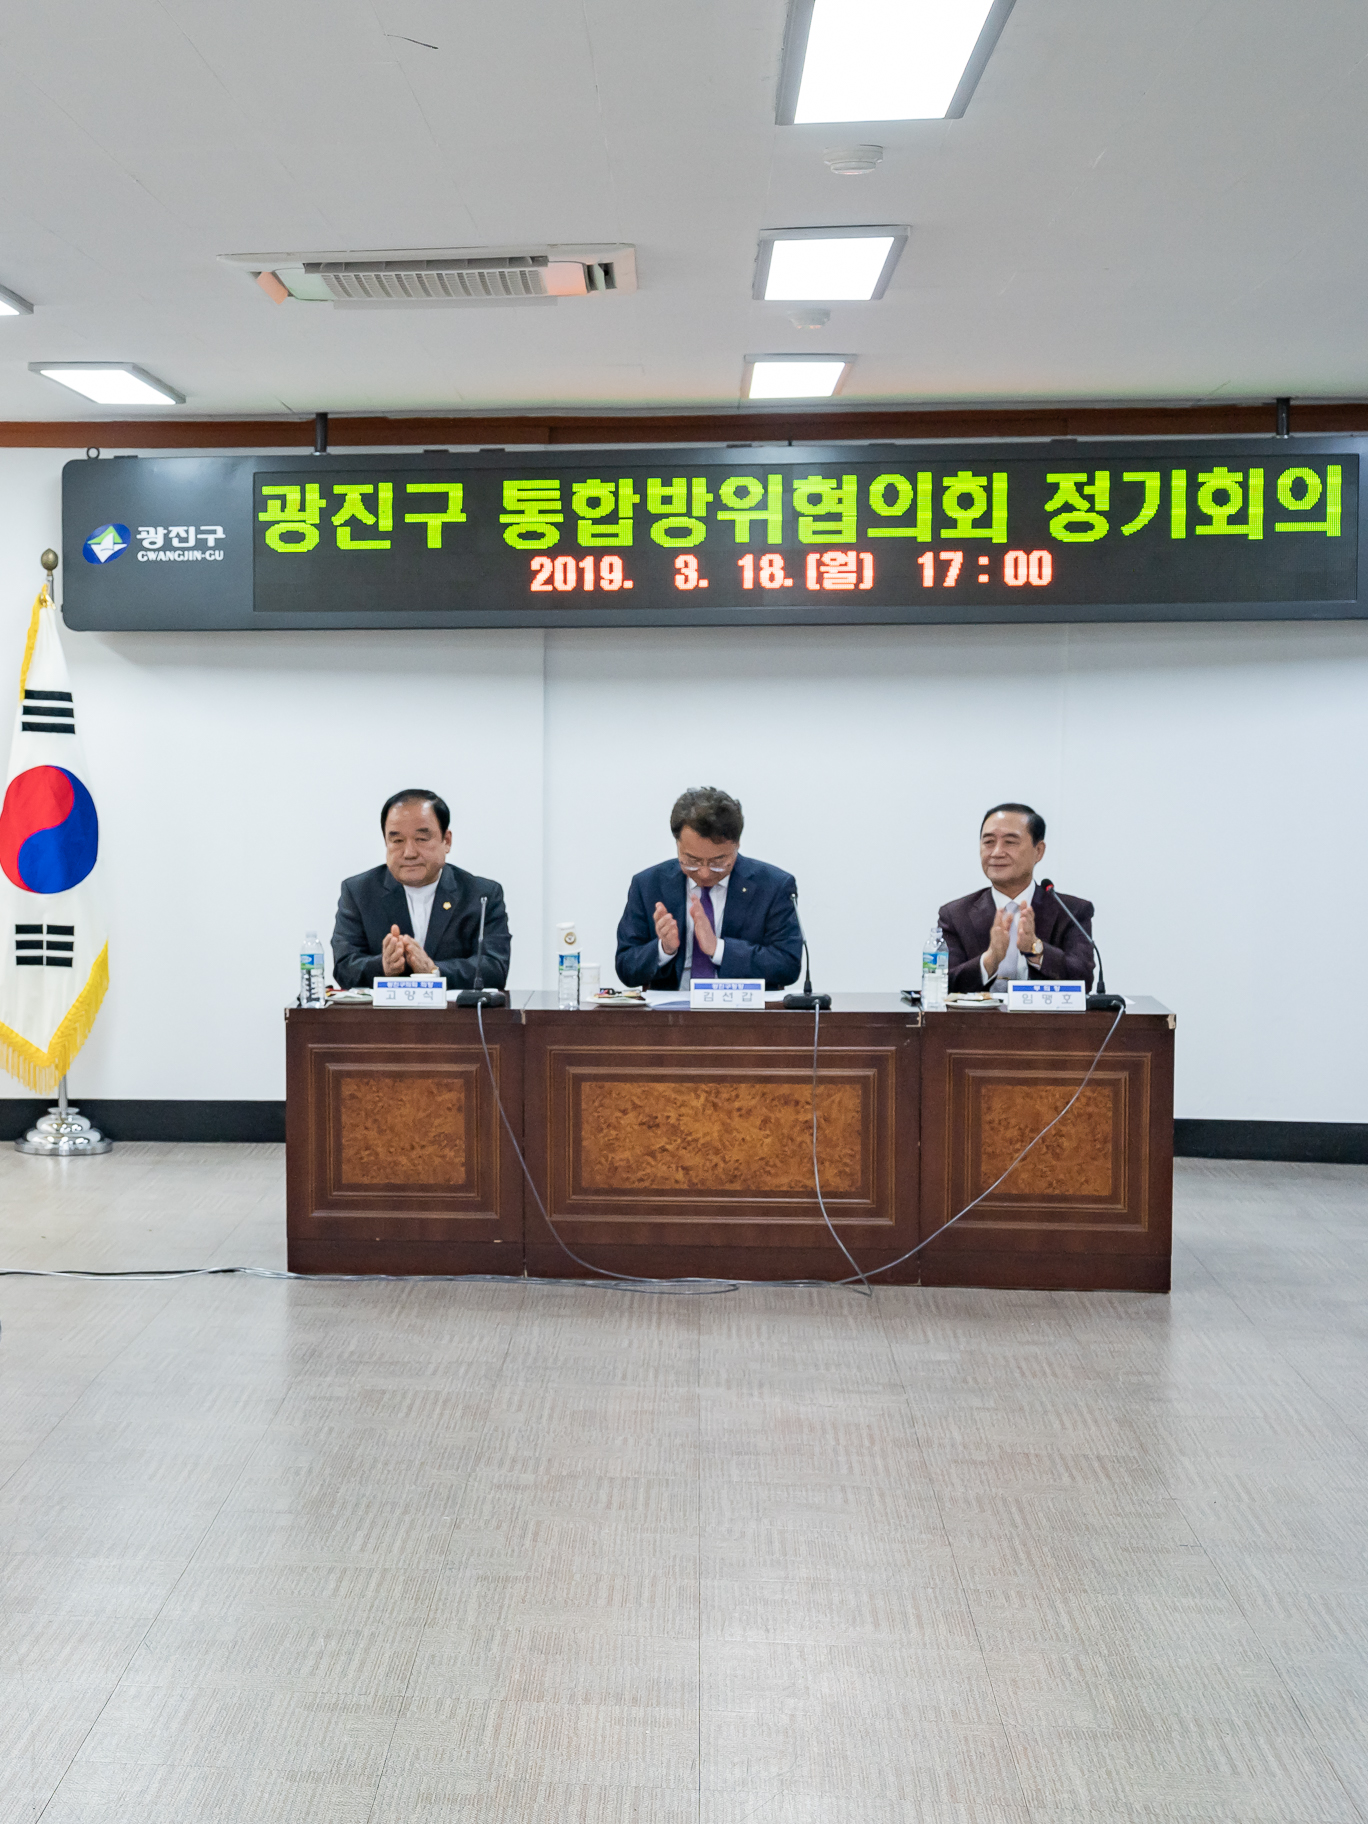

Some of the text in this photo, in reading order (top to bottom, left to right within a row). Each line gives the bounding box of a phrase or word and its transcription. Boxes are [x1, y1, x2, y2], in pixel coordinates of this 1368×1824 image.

[258, 465, 1342, 553] 광진구 통합방위협의회 정기회의
[136, 525, 226, 549] 광진구
[137, 550, 224, 562] GWANGJIN-GU
[531, 555, 634, 592] 2019.
[674, 554, 709, 590] 3.
[386, 990, 433, 1001] 고양석
[703, 991, 752, 1002] 김선갑
